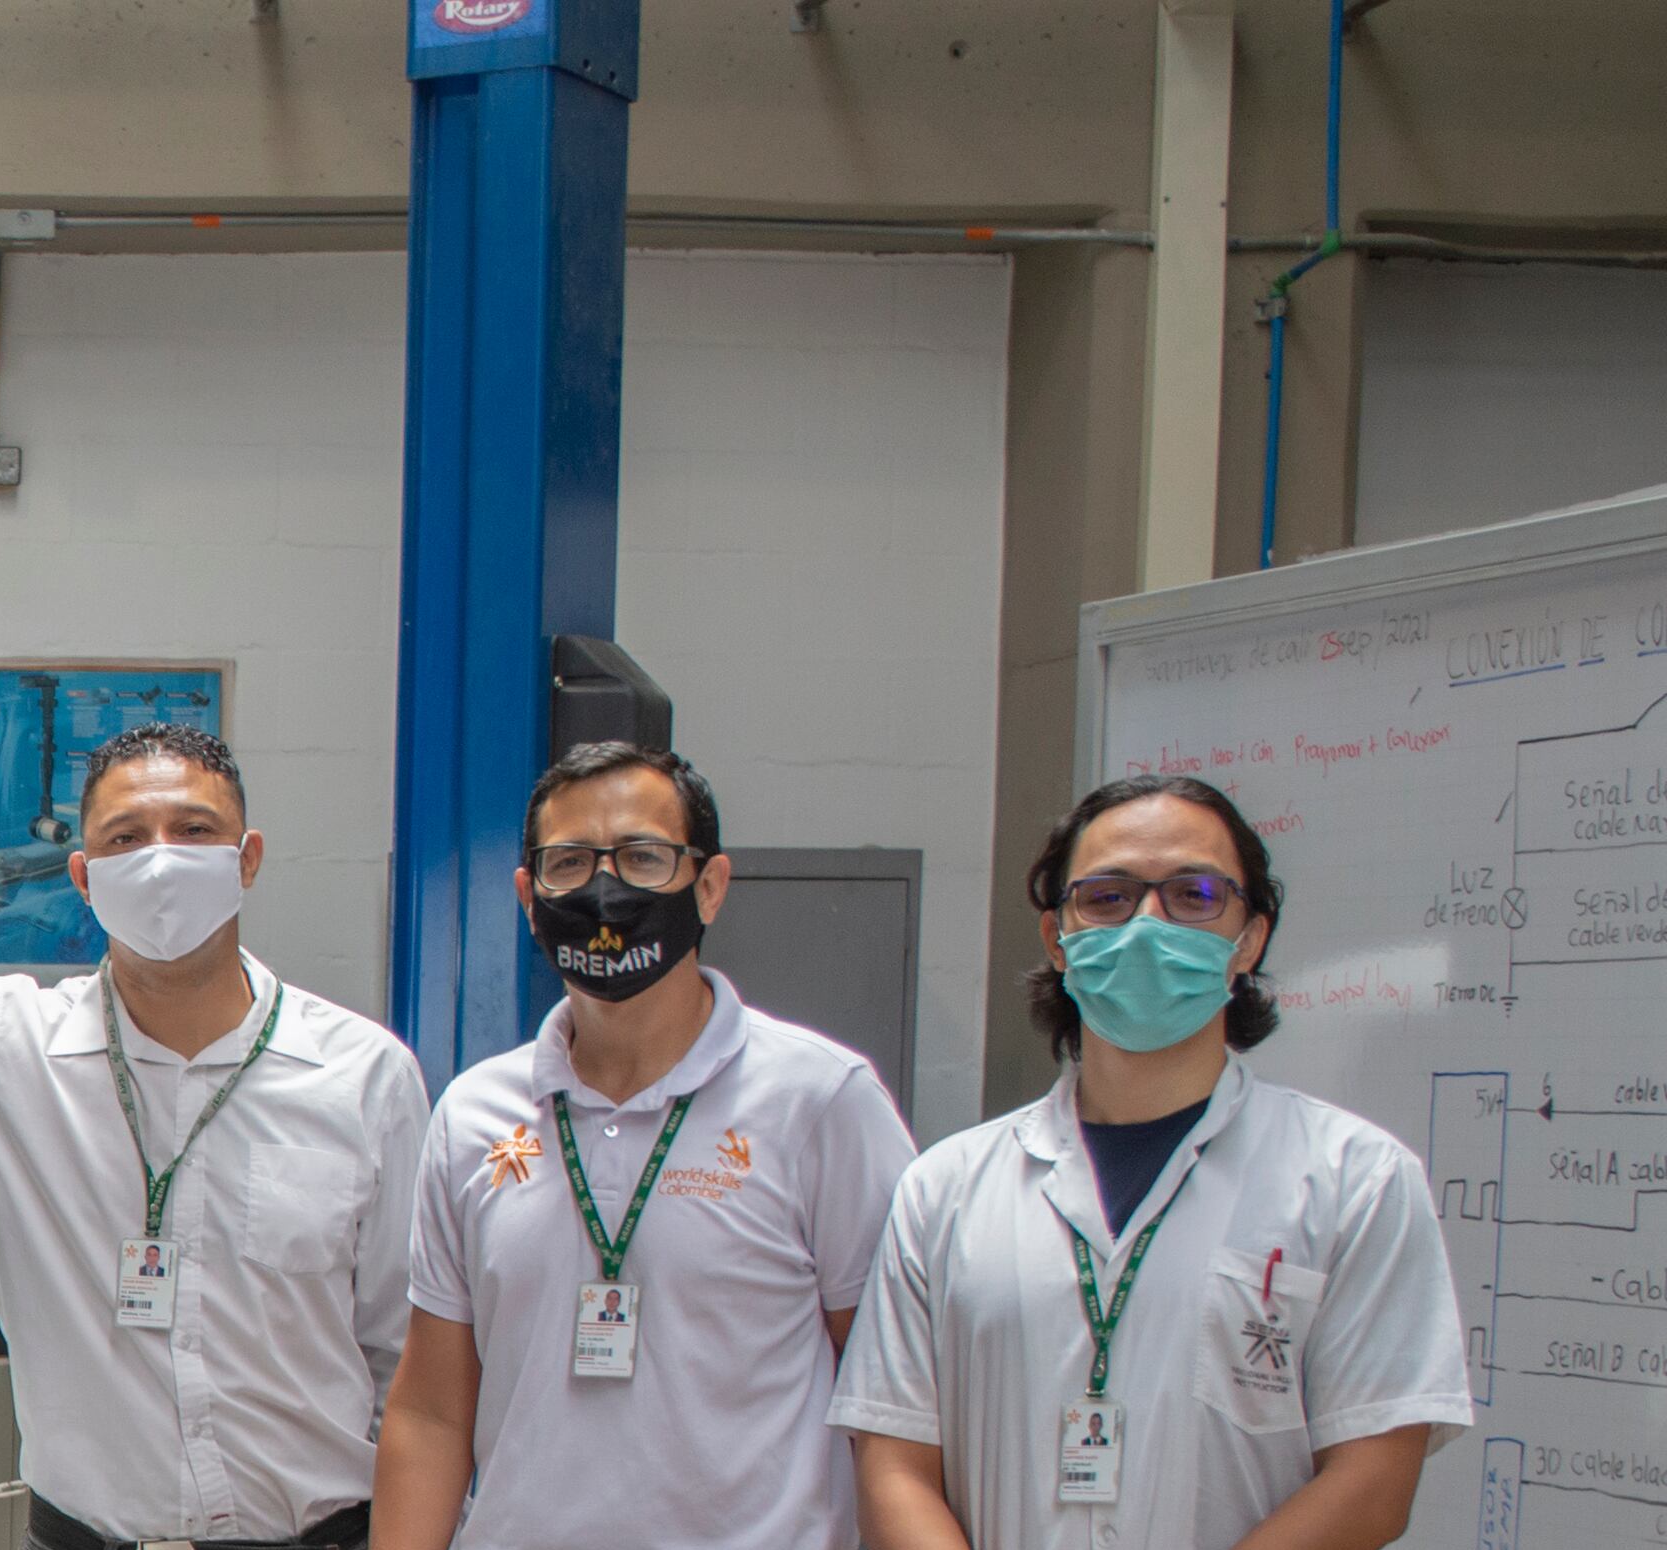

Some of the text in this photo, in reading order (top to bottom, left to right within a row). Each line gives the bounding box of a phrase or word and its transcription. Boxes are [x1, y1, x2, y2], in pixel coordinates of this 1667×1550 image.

[444, 0, 519, 21] Rotary
[1581, 615, 1607, 659] DE
[1635, 603, 1667, 647] CO
[1574, 809, 1628, 840] cable
[1451, 860, 1494, 895] LUZ
[1568, 920, 1620, 947] cable
[556, 941, 662, 977] BREMIN
[1614, 1076, 1659, 1104] cable
[1605, 1150, 1620, 1185] A
[657, 1180, 723, 1200] Colombia
[1535, 1445, 1562, 1476] 30
